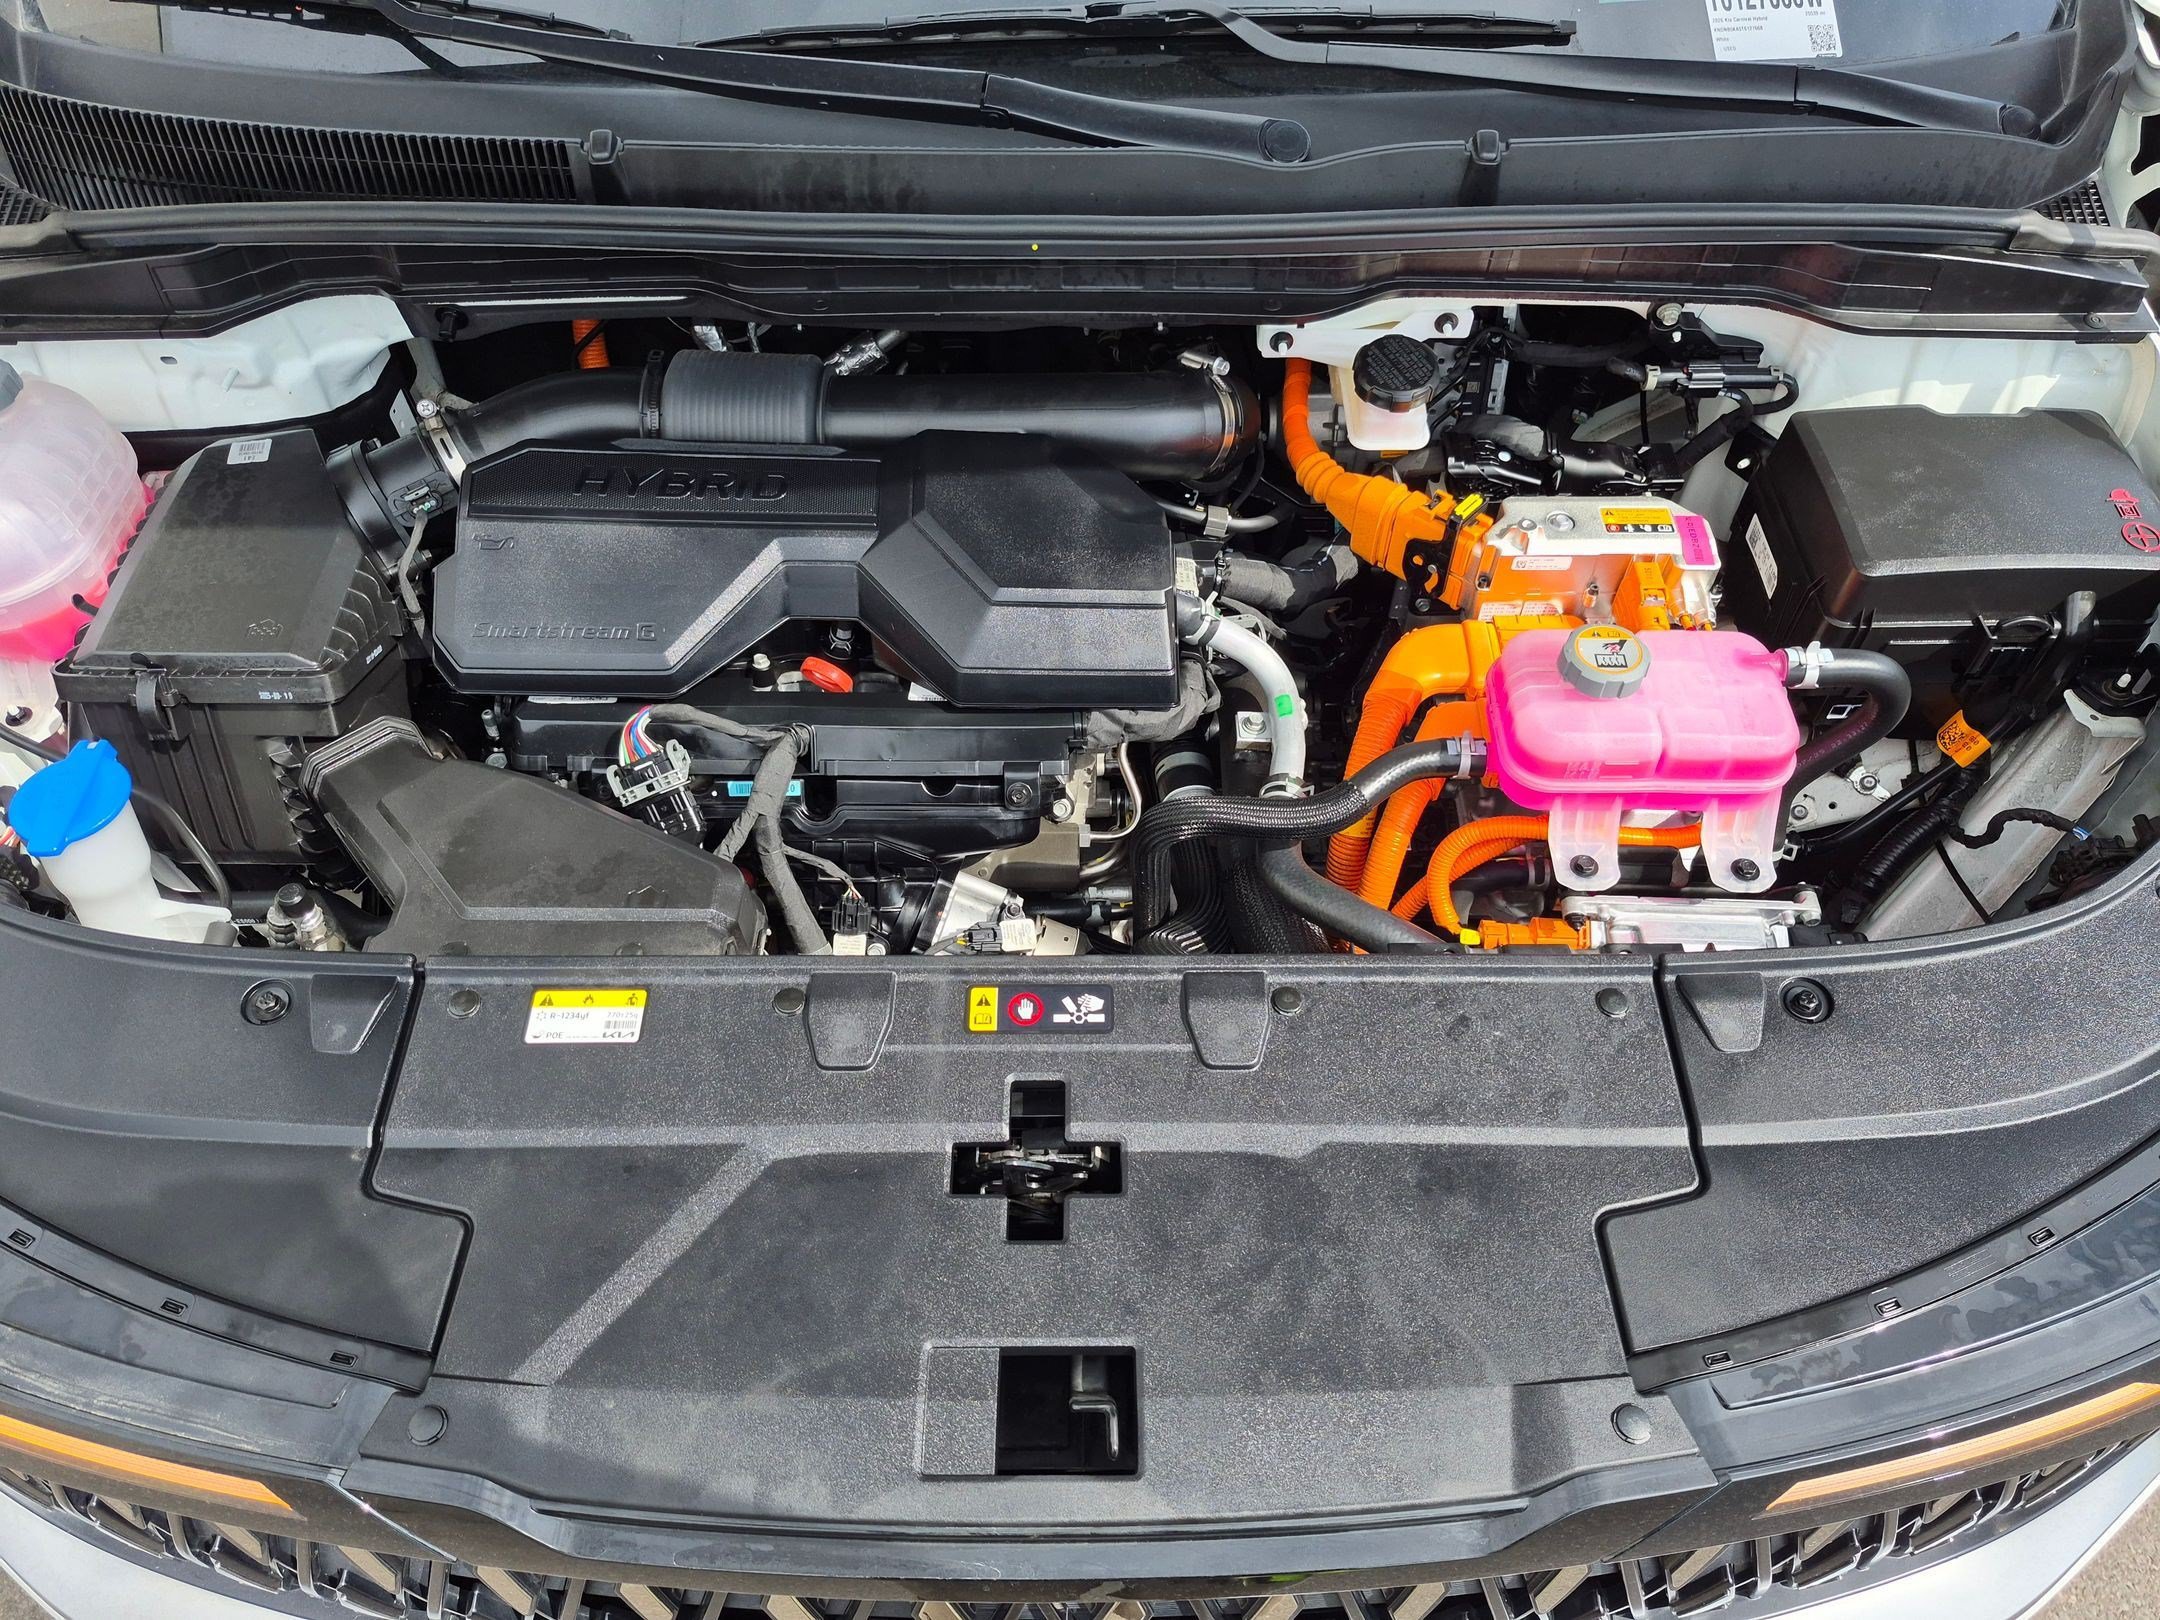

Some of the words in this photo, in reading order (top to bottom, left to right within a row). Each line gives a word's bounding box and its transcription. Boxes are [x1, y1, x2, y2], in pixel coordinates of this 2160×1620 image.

[572, 466, 788, 501] HYBRID
[472, 622, 631, 640] Smartstream
[602, 1031, 635, 1039] KIA
